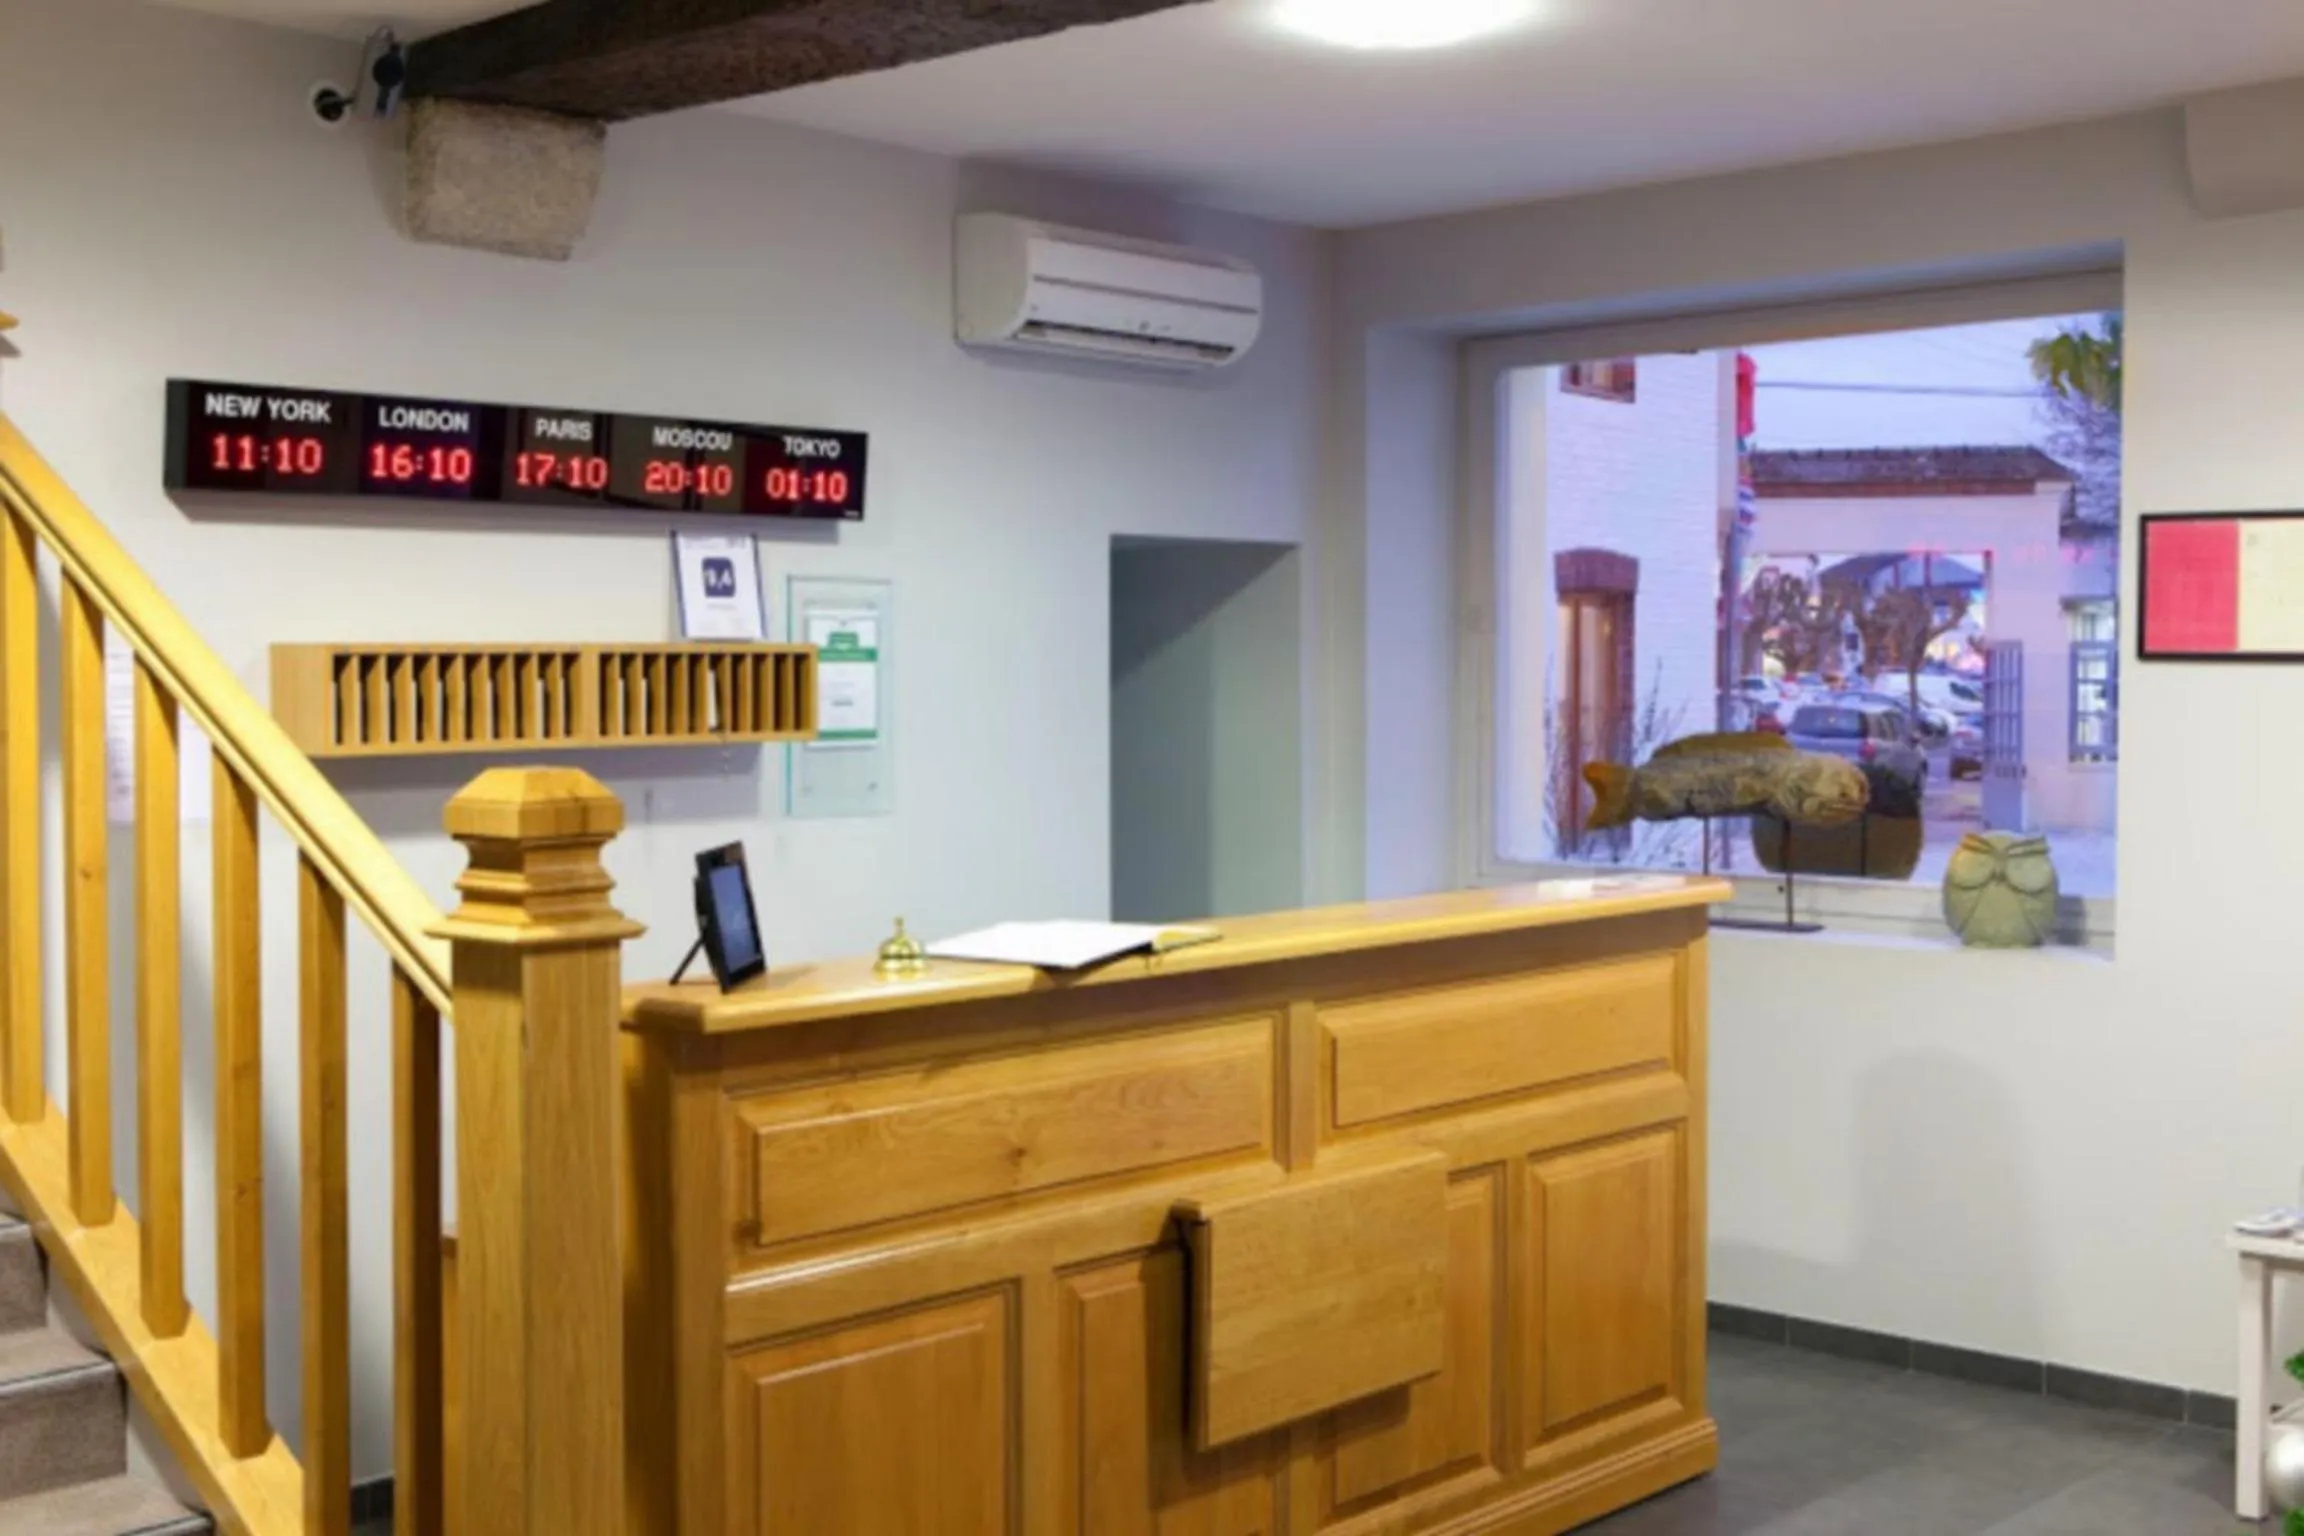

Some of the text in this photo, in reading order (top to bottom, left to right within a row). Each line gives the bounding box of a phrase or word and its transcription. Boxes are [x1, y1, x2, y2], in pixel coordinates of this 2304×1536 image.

[205, 393, 331, 423] NEW YORK
[379, 406, 469, 432] LONDON
[535, 417, 593, 441] PARIS
[653, 426, 732, 451] MOSCOU
[213, 433, 323, 474] 11:10
[783, 435, 841, 458] TOKYO
[371, 443, 473, 483] 16:10
[516, 453, 608, 489] 17:10
[644, 462, 733, 495] 20:10
[766, 468, 848, 502] 01:10
